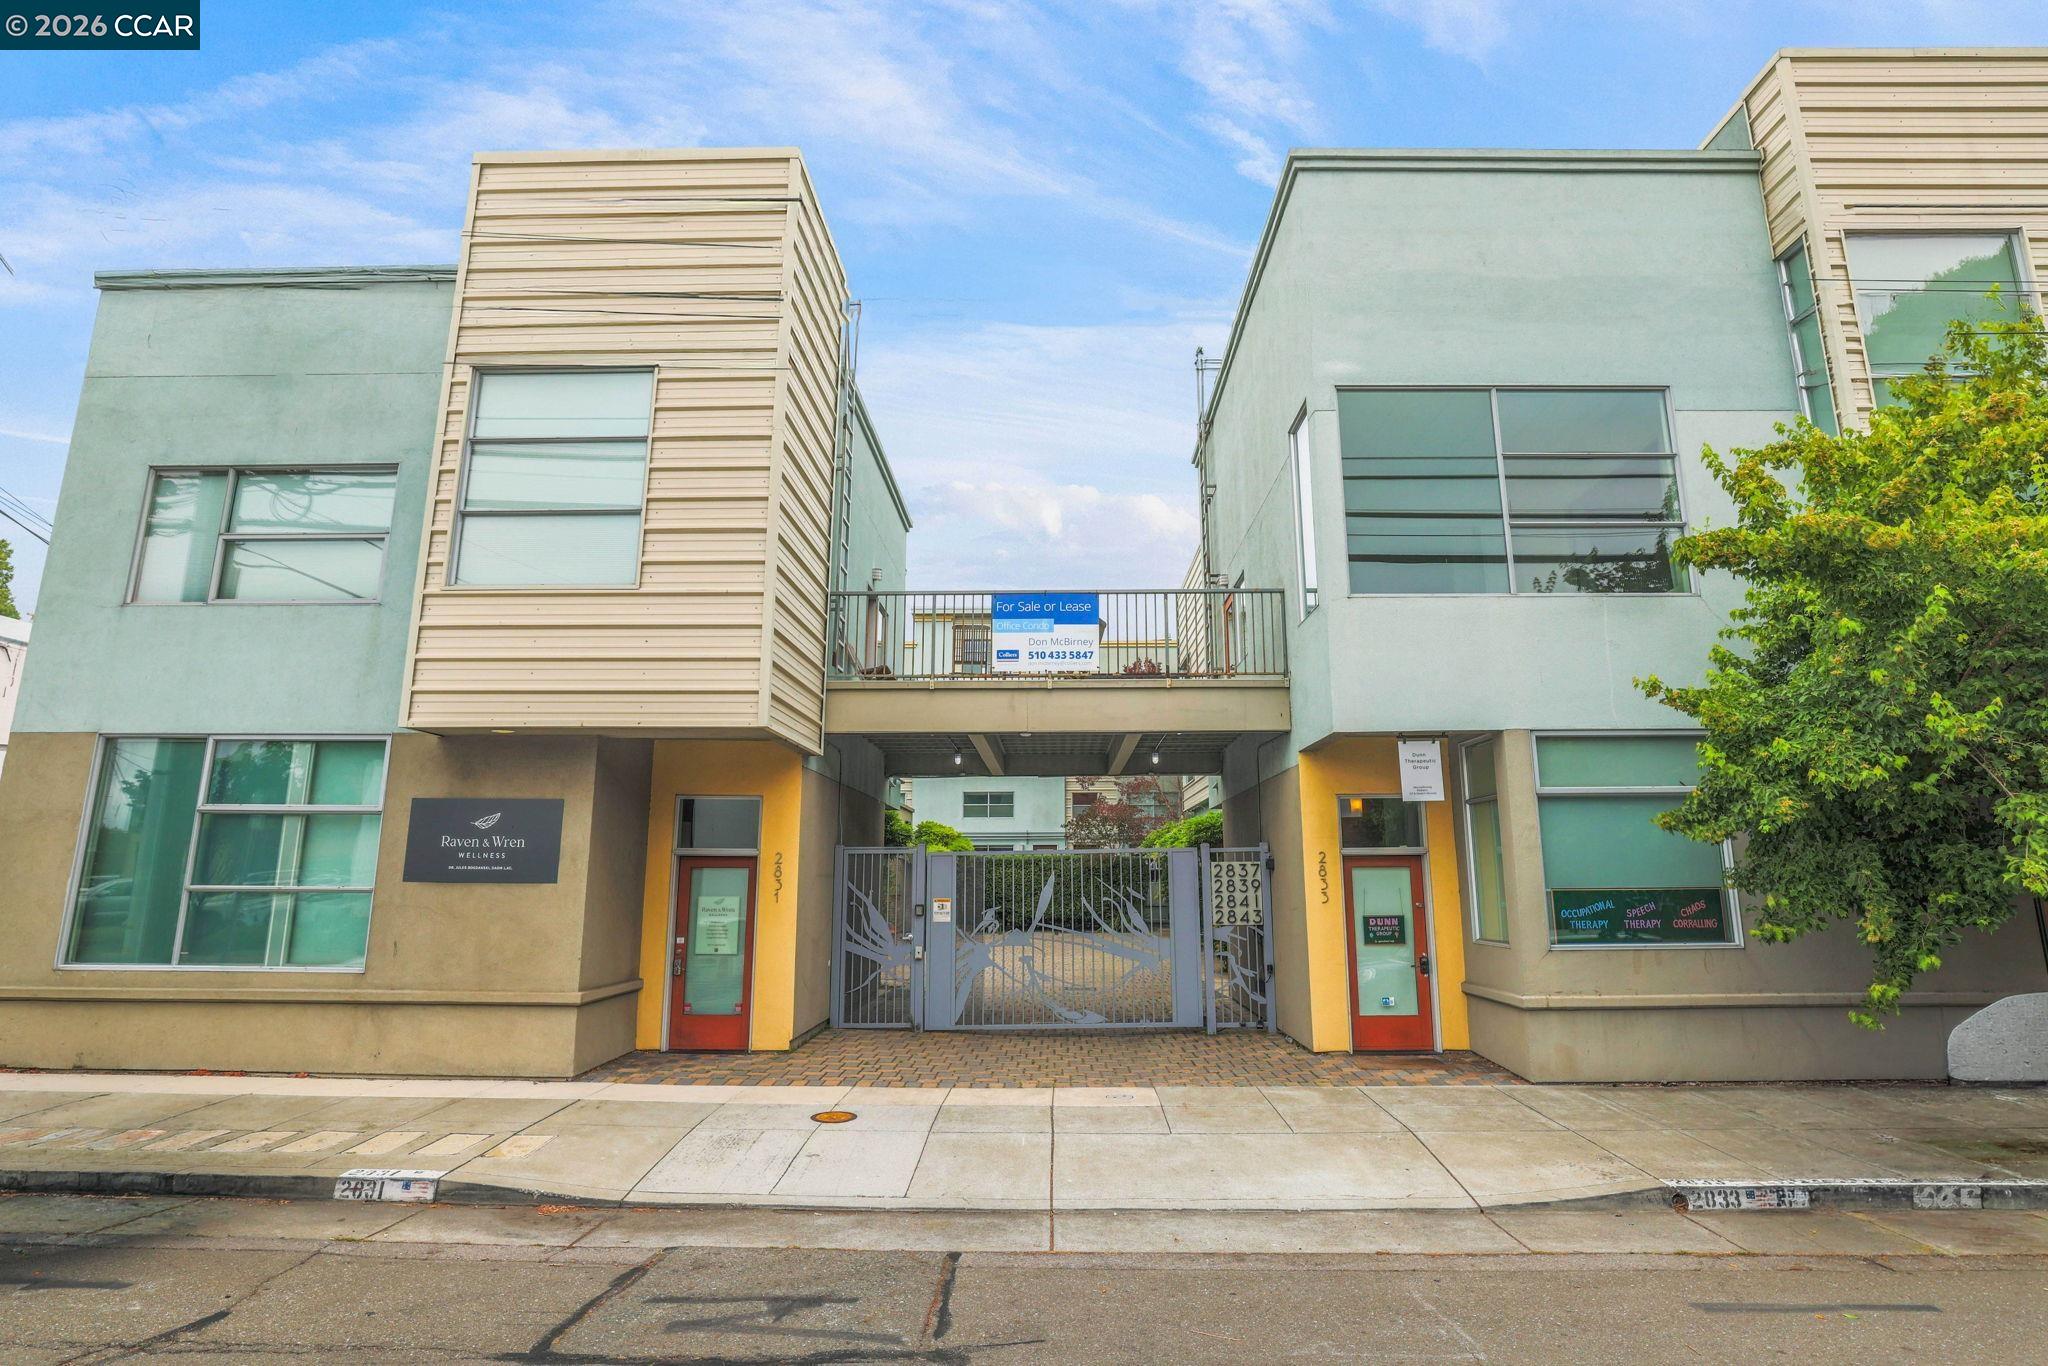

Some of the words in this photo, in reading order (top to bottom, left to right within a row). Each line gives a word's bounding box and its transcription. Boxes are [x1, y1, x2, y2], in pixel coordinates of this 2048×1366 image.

[996, 601, 1014, 612] For
[1017, 600, 1041, 612] Sale
[1043, 603, 1056, 612] or
[1059, 601, 1092, 612] Lease
[996, 621, 1021, 630] Office
[1022, 621, 1050, 630] Condo
[1028, 637, 1048, 646] Don
[1050, 637, 1094, 648] McBirney
[1028, 651, 1046, 660] 510
[1047, 651, 1067, 660] 433
[1069, 651, 1094, 660] 5847
[441, 835, 479, 848] Raven
[482, 838, 490, 848] &
[492, 835, 526, 848] Wren
[1213, 863, 1260, 878] 2837
[1318, 851, 1329, 905] 2833
[1214, 878, 1261, 894] 2839
[1214, 894, 1259, 909] 2841
[1560, 899, 1615, 919] OCCUPATIONAL
[1626, 901, 1657, 919] SPEECH
[1680, 900, 1707, 918] CHAOS
[1215, 909, 1263, 925] 2843
[1369, 917, 1399, 926] DUNN
[1569, 919, 1609, 930] THERAPY
[1623, 919, 1661, 930] THERAPY
[1672, 918, 1718, 930] CORRALLING
